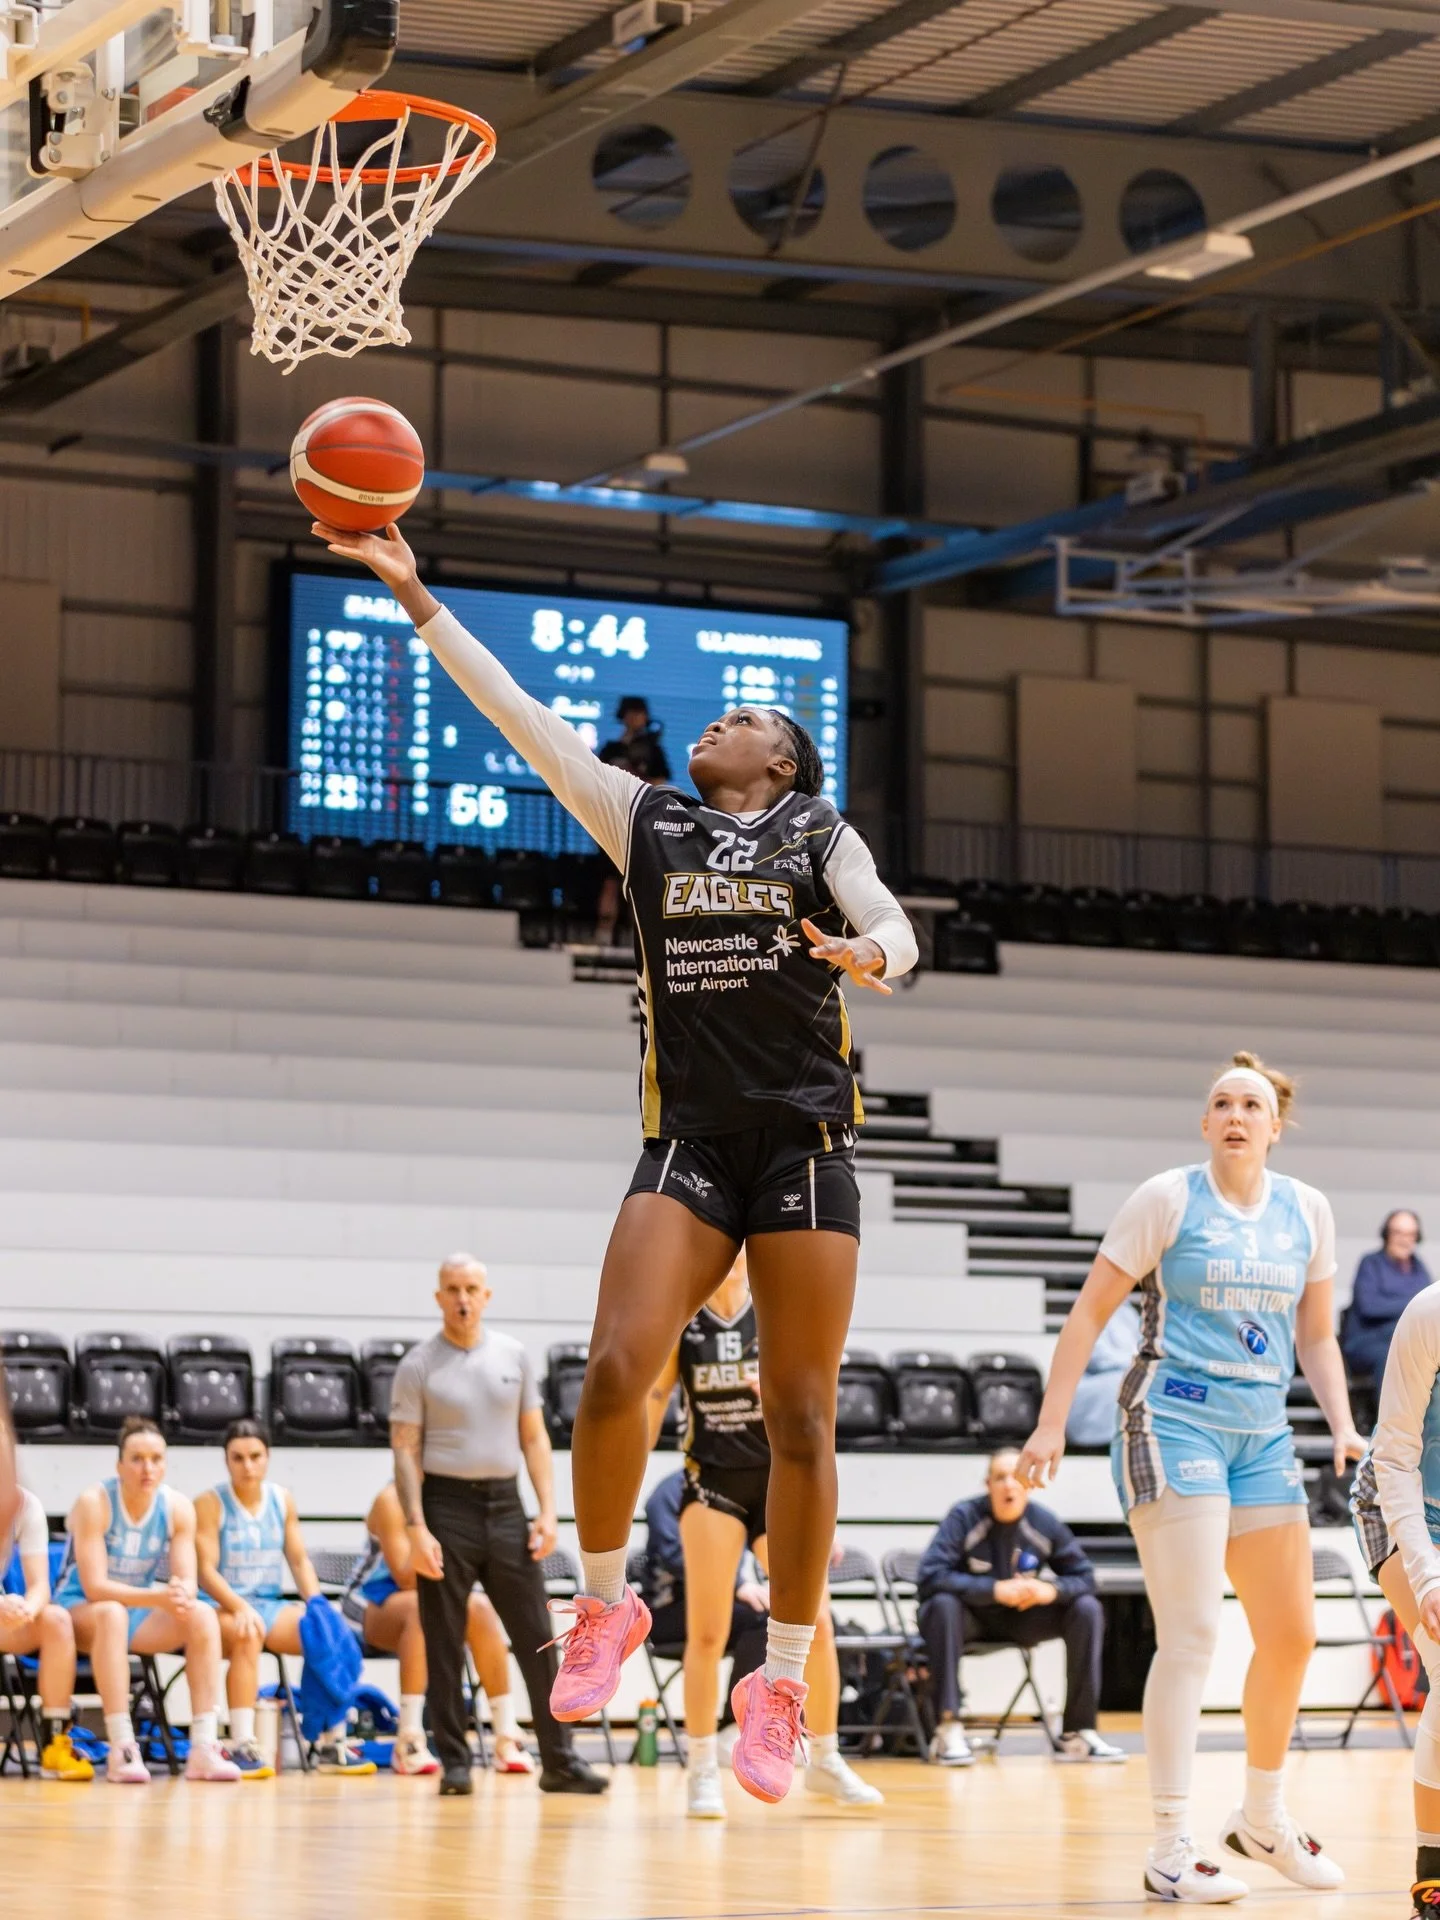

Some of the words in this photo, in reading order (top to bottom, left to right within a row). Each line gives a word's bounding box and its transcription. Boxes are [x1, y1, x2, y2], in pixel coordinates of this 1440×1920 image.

[531, 609, 649, 661] 8:44
[653, 820, 682, 833] ENIGMA
[682, 821, 695, 833] TAP
[706, 829, 759, 872] 22
[665, 874, 792, 918] EAGLES
[665, 933, 759, 956] Newcastle
[666, 954, 779, 977] International
[667, 980, 697, 994] Your
[700, 976, 750, 993] Airport
[1239, 1227, 1260, 1260] 3
[715, 1331, 743, 1361] 15
